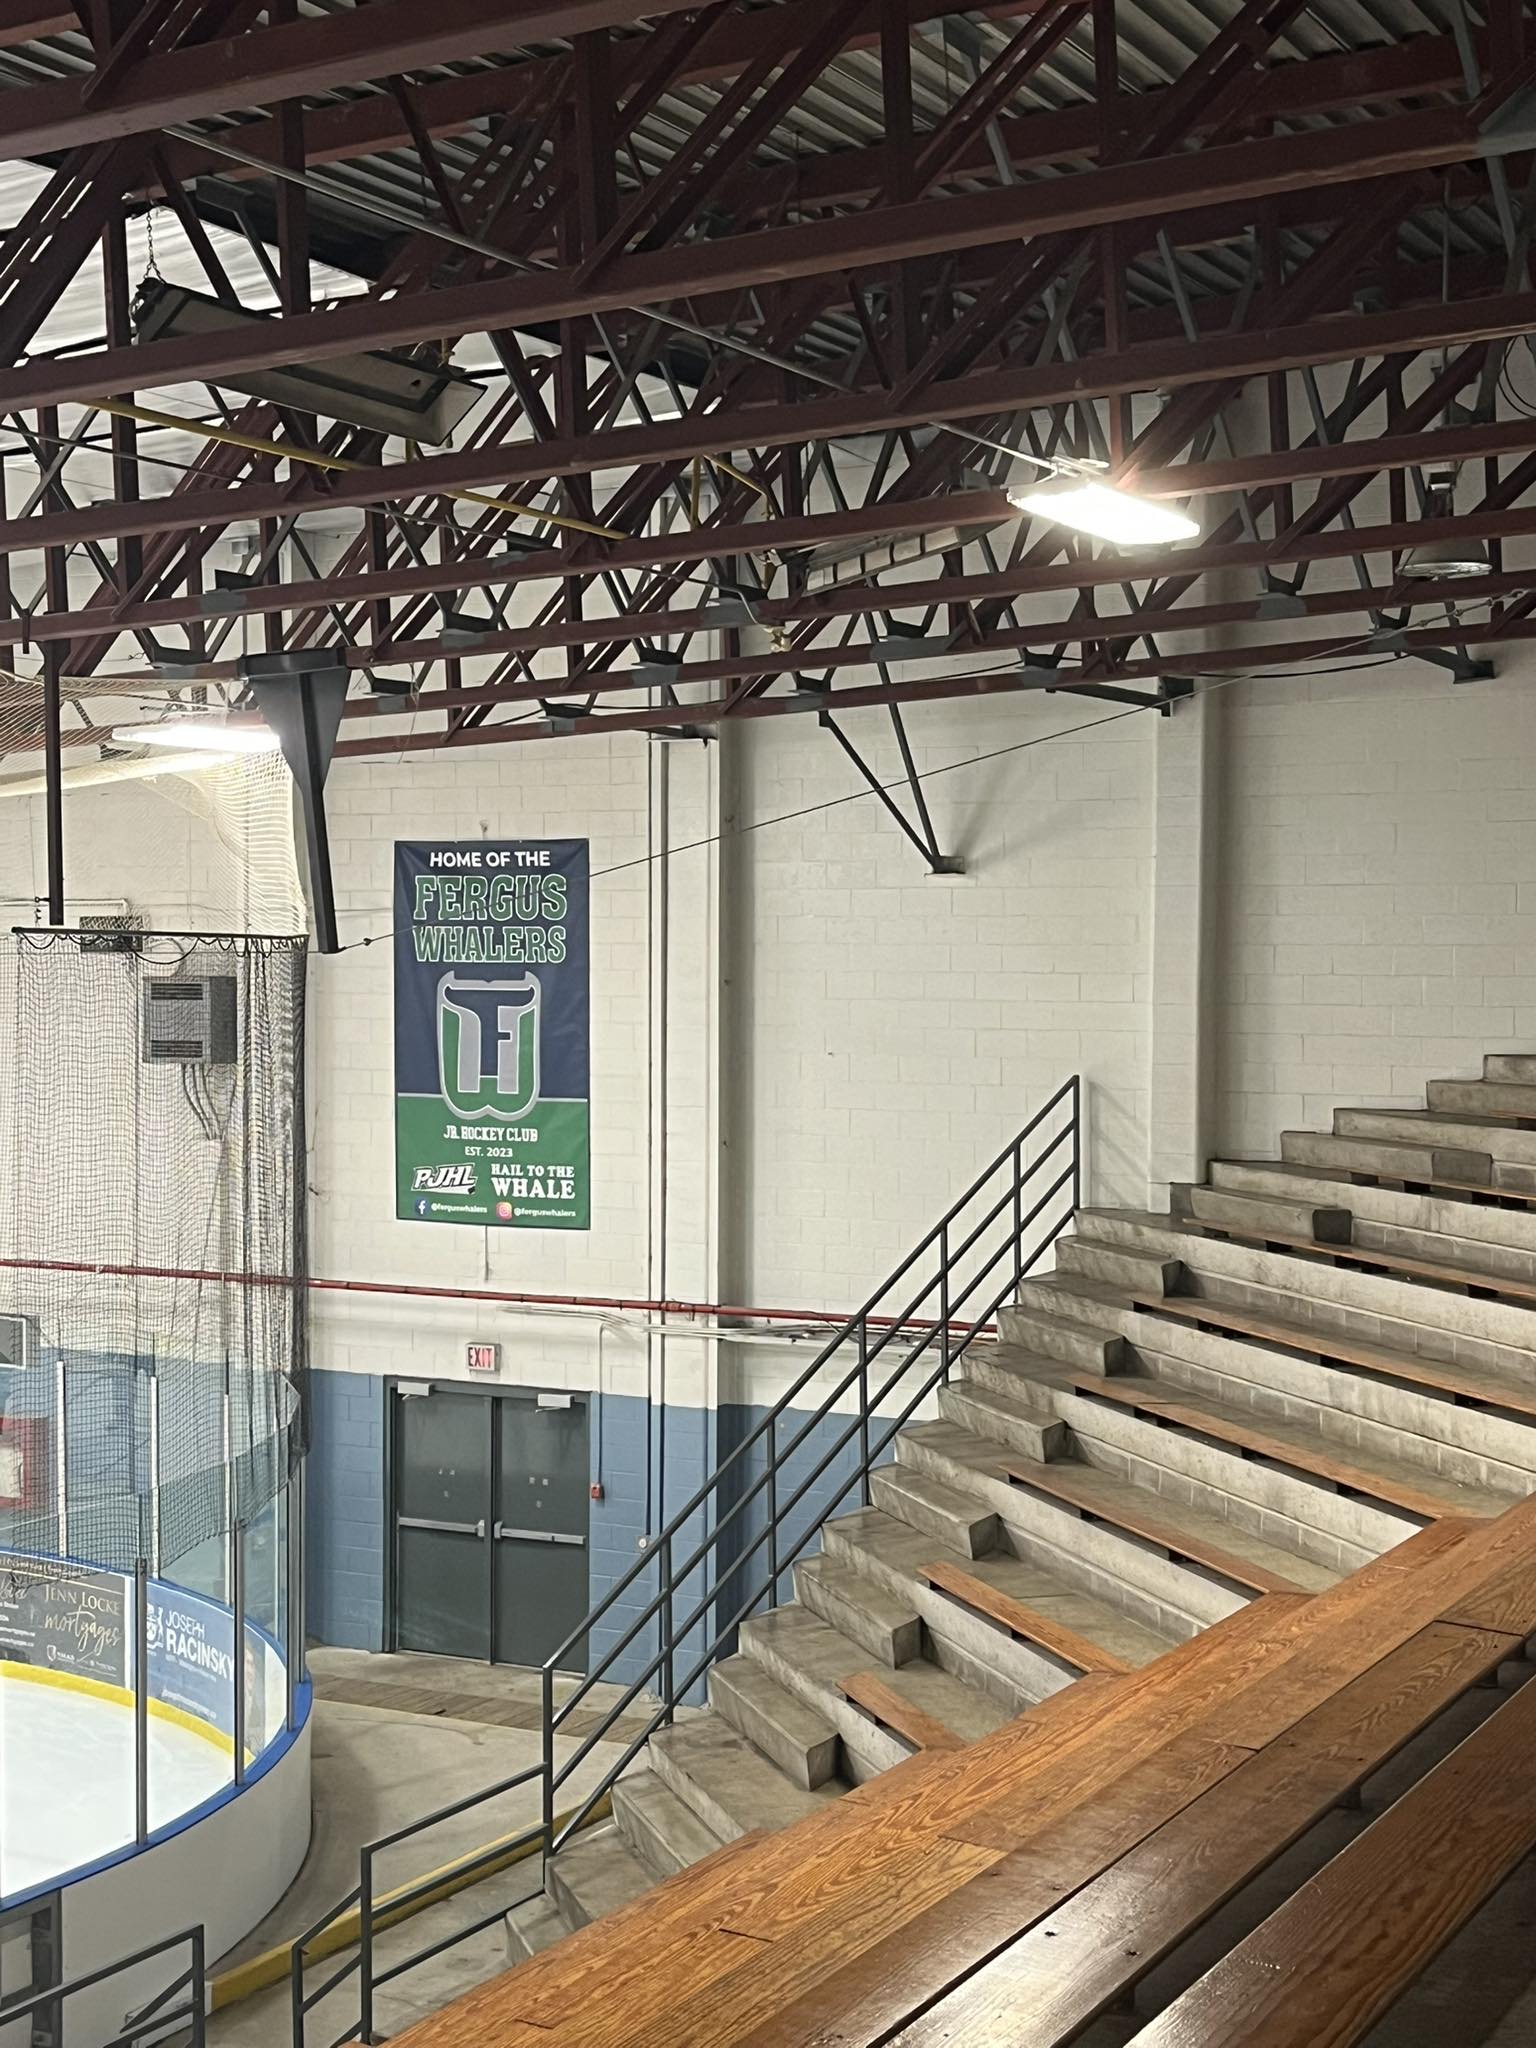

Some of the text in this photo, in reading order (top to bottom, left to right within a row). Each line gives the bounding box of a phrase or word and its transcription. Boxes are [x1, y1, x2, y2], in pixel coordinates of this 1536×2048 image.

[430, 851, 551, 868] HOME OF THE
[413, 874, 568, 921] FERGUS
[412, 926, 567, 964] WHALERS
[461, 1126, 505, 1141] HOCKEY
[506, 1128, 538, 1142] CLUB
[465, 1146, 513, 1157] EST. 2023
[413, 1165, 476, 1189] PJHL
[491, 1164, 575, 1178] HAIL TO THE
[490, 1177, 576, 1199] WHALE
[468, 1347, 492, 1368] EXIT
[44, 1584, 77, 1604] JENN
[82, 1592, 121, 1616] LOCKE
[166, 1610, 205, 1639] JOSEPH
[166, 1628, 234, 1681] RACINSKY
